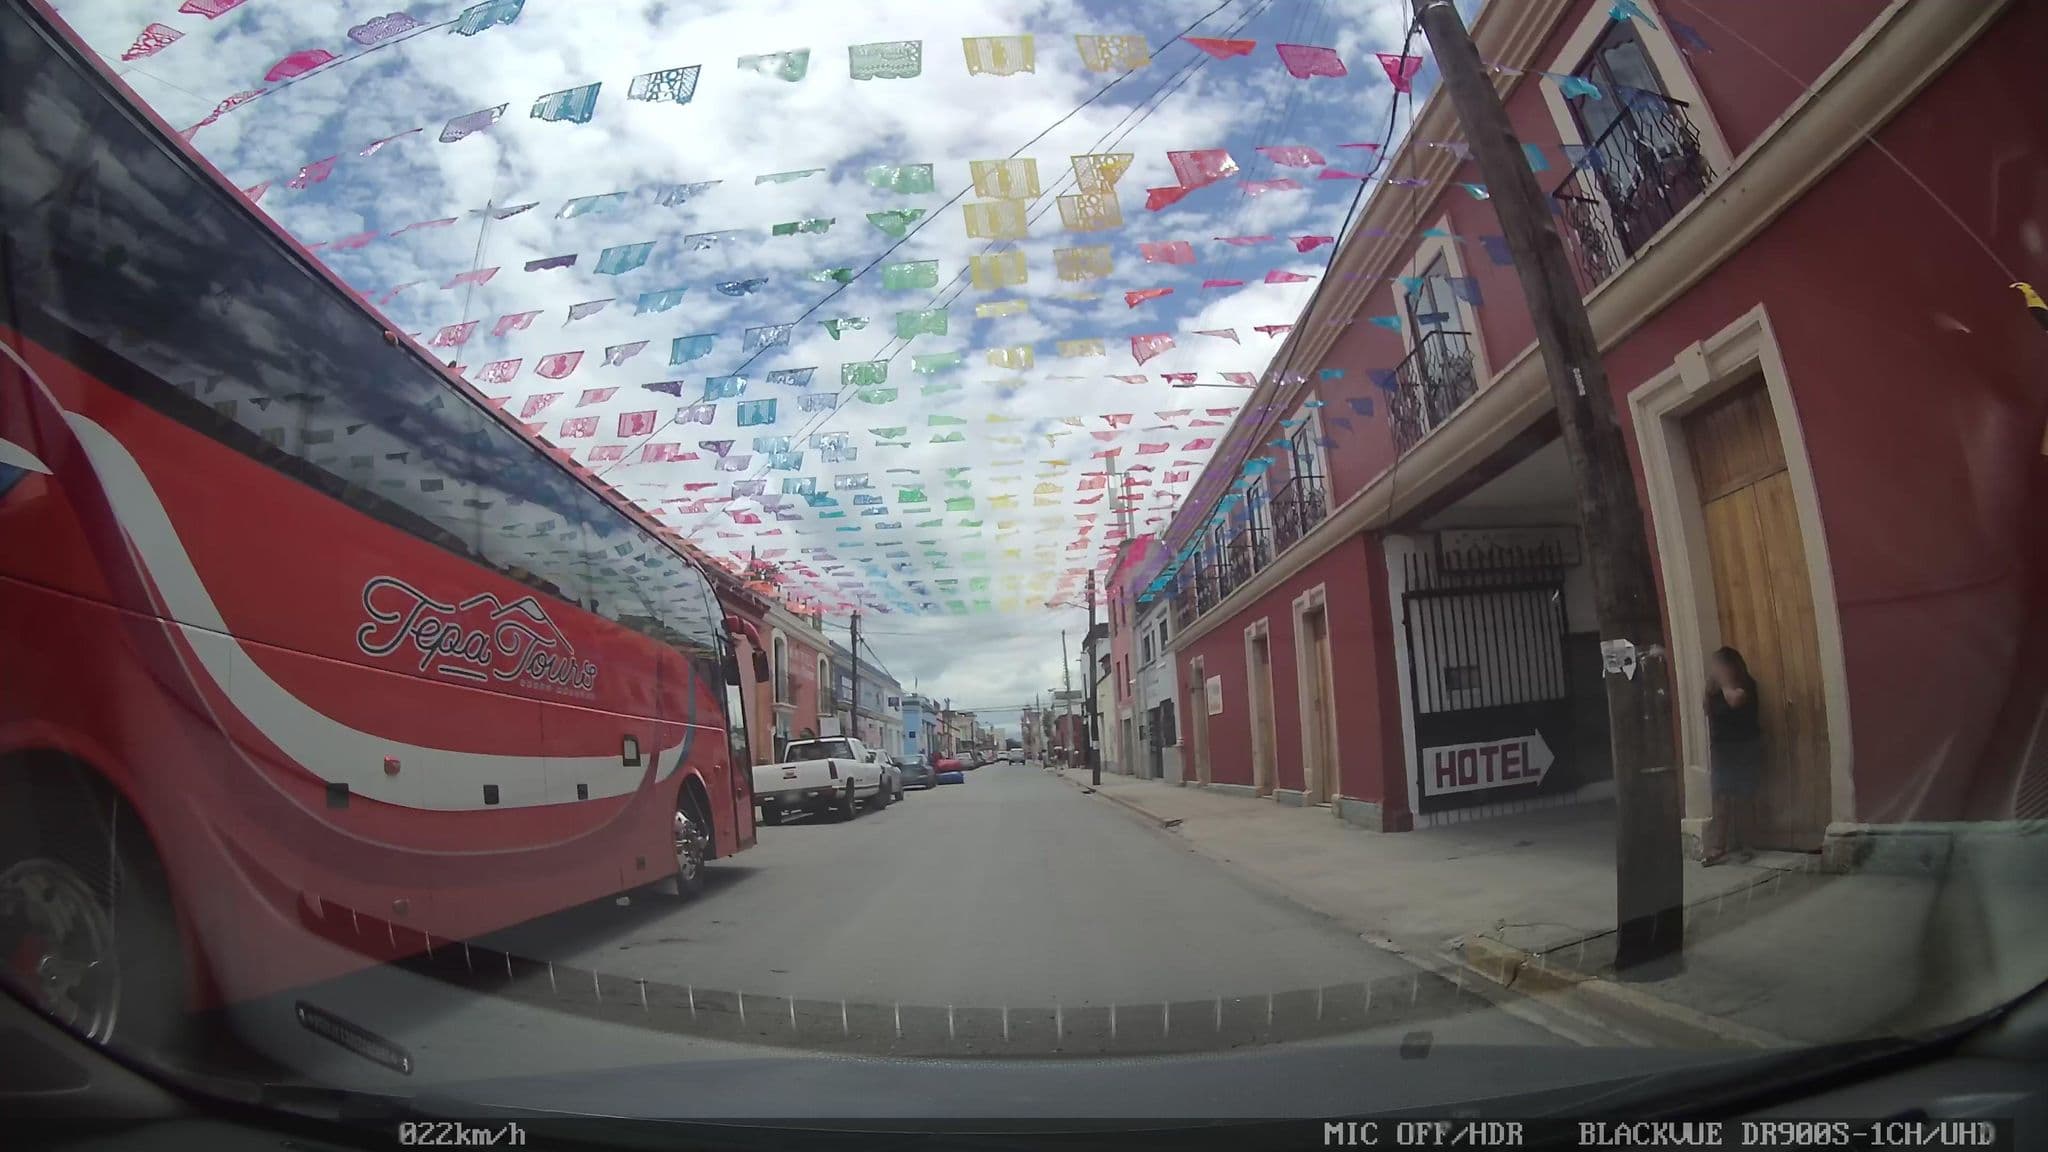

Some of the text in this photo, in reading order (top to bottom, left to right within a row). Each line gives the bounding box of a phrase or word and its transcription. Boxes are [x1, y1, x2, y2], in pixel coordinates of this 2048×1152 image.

[356, 576, 597, 689] Tepa Tours
[1435, 741, 1541, 788] HOTEL
